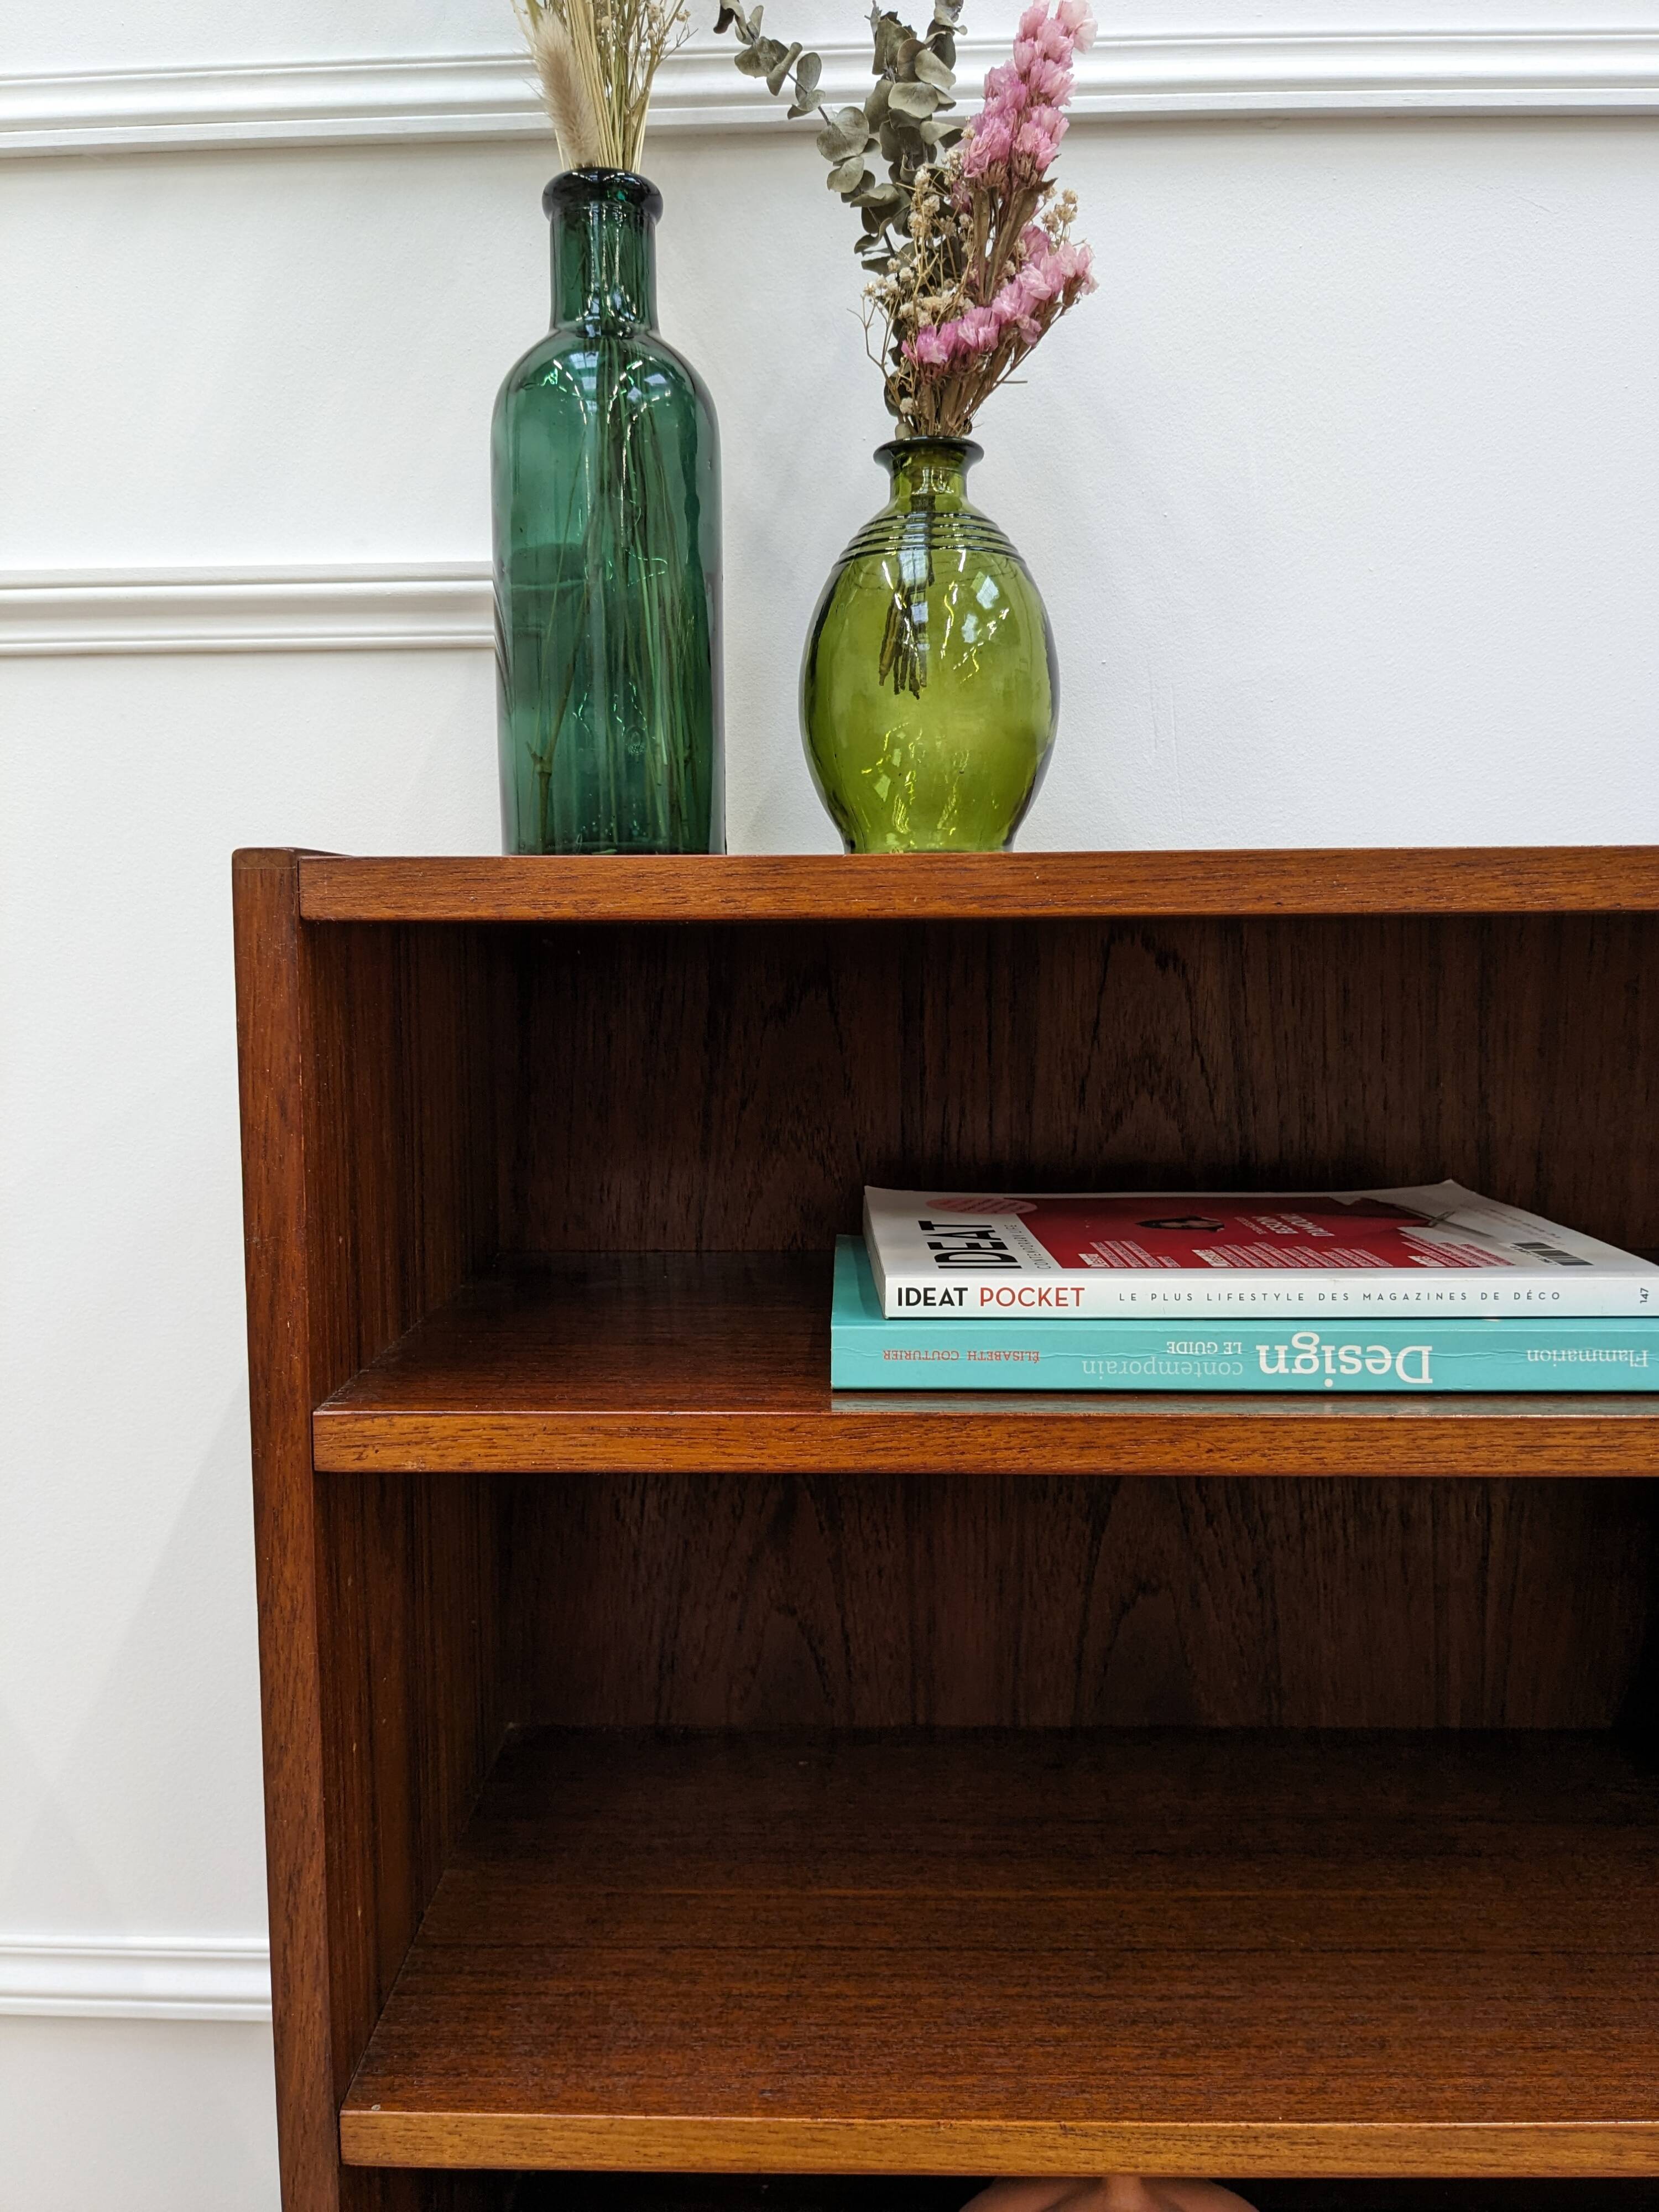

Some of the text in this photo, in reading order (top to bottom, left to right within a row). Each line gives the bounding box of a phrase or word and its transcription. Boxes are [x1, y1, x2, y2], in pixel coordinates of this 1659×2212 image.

[918, 1220, 1022, 1269] IDEAT
[898, 1287, 1085, 1307] IDEAT POCKET
[1119, 1289, 1561, 1302] LE PLUS LIFESTYLE DES MAGAZINES DE DÉCO
[1640, 1287, 1649, 1304] 147
[884, 1350, 1040, 1364] ÉLISABETH COUTURIER
[1167, 1341, 1243, 1354] LE GUIDE
[1082, 1357, 1243, 1379] contemporain
[1256, 1331, 1433, 1387] Design
[1527, 1349, 1648, 1368] Flammarion
